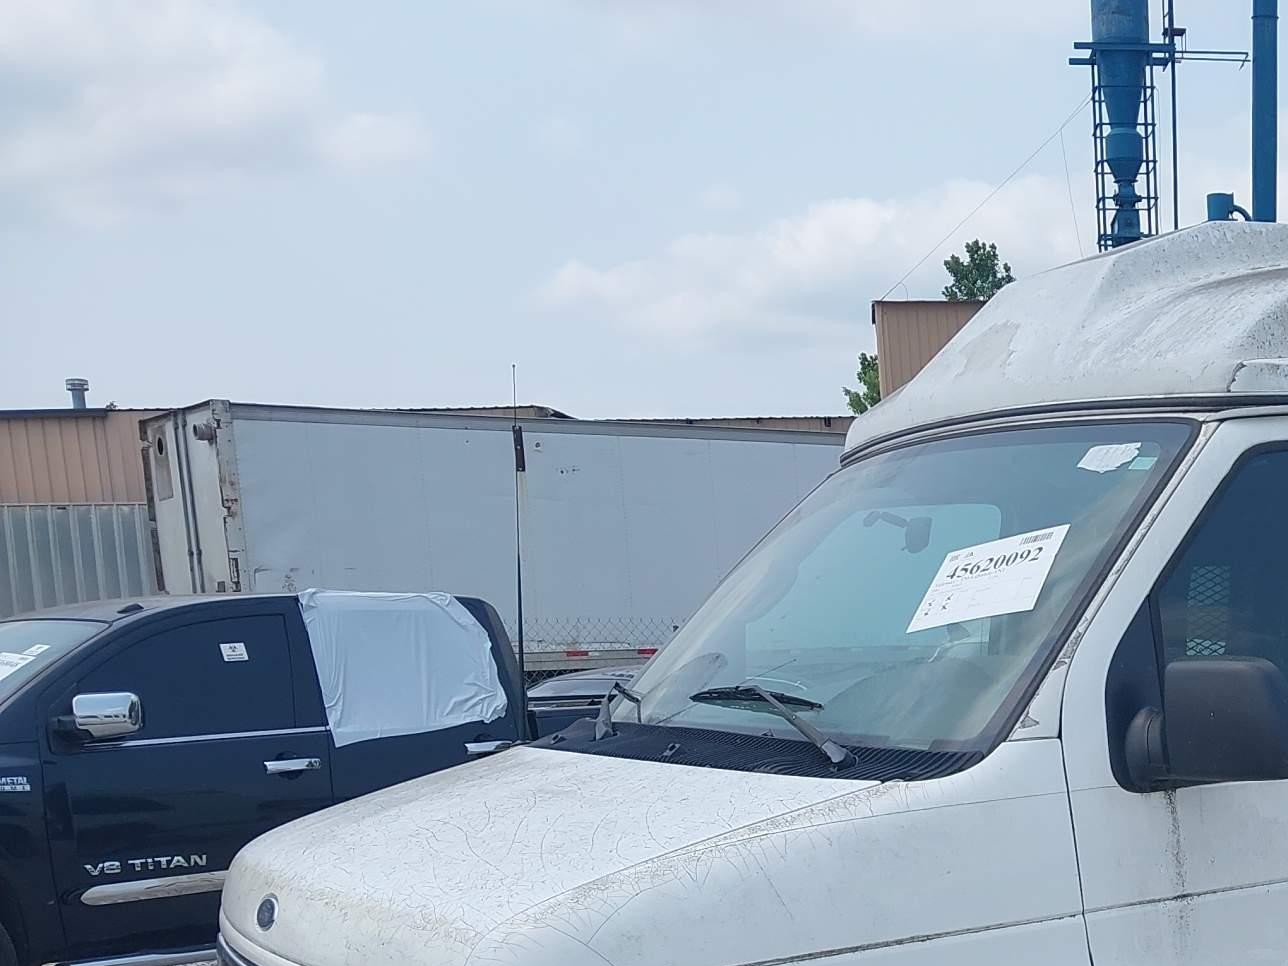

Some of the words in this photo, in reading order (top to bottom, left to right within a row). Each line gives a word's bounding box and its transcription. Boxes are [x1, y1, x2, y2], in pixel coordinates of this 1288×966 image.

[946, 547, 1043, 579] 45620092
[83, 861, 121, 876] V8
[127, 854, 207, 871] TITAN
